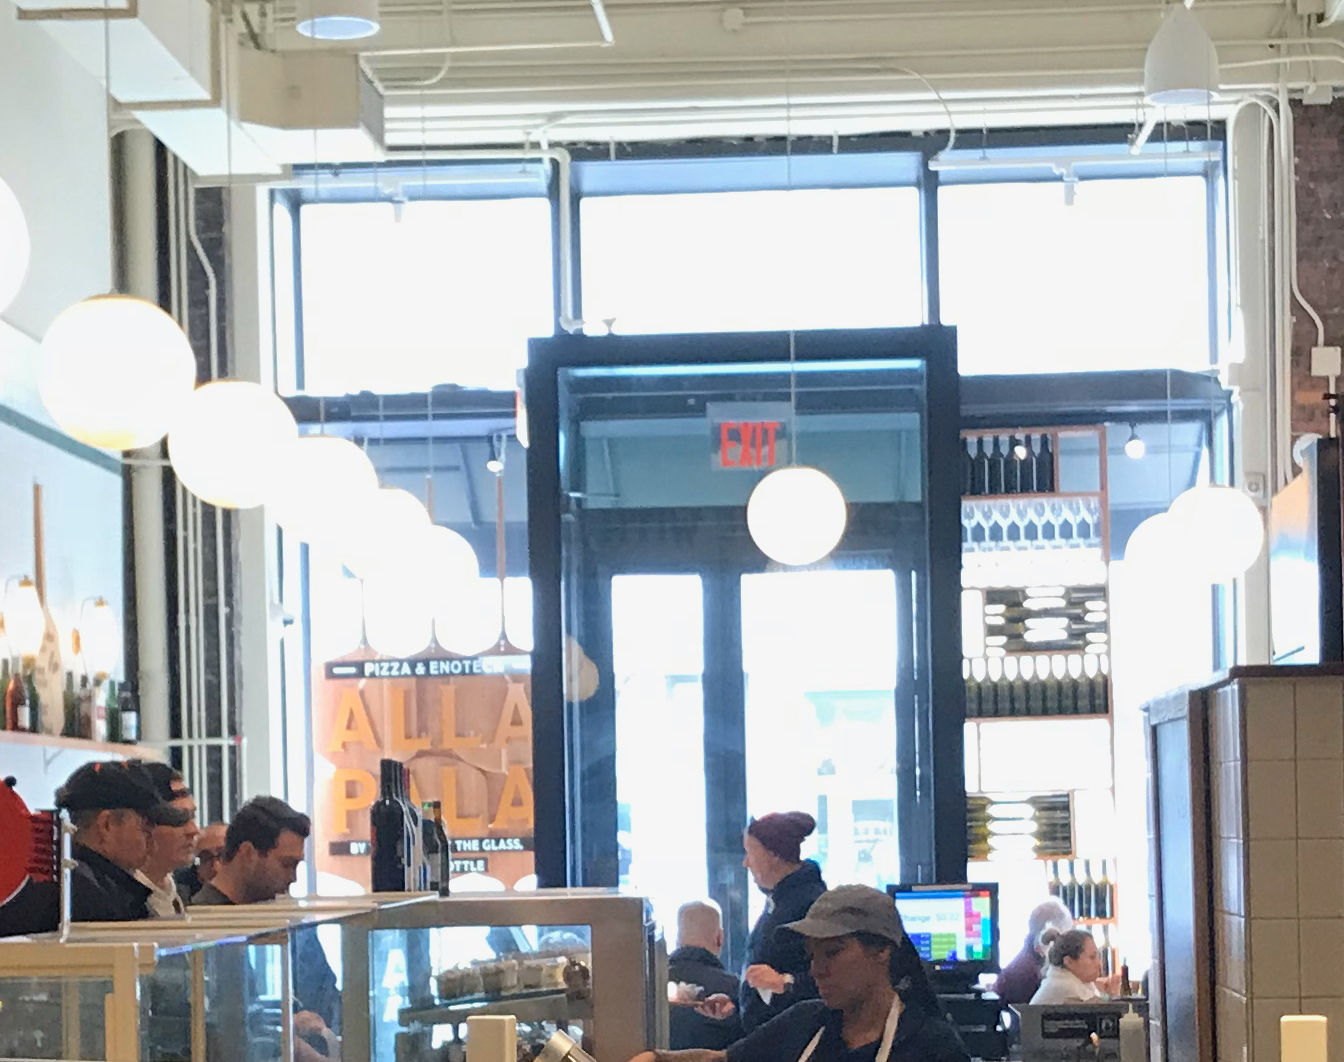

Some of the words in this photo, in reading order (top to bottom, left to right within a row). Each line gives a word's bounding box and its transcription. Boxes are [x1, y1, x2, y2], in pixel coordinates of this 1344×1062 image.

[720, 422, 780, 467] EXIT
[364, 661, 411, 676] PIZZA
[415, 661, 426, 675] &
[328, 683, 532, 752] ALLA
[333, 764, 533, 834] PLA
[350, 841, 367, 855] BY
[455, 839, 480, 852] THE
[449, 859, 485, 872] OTTLE
